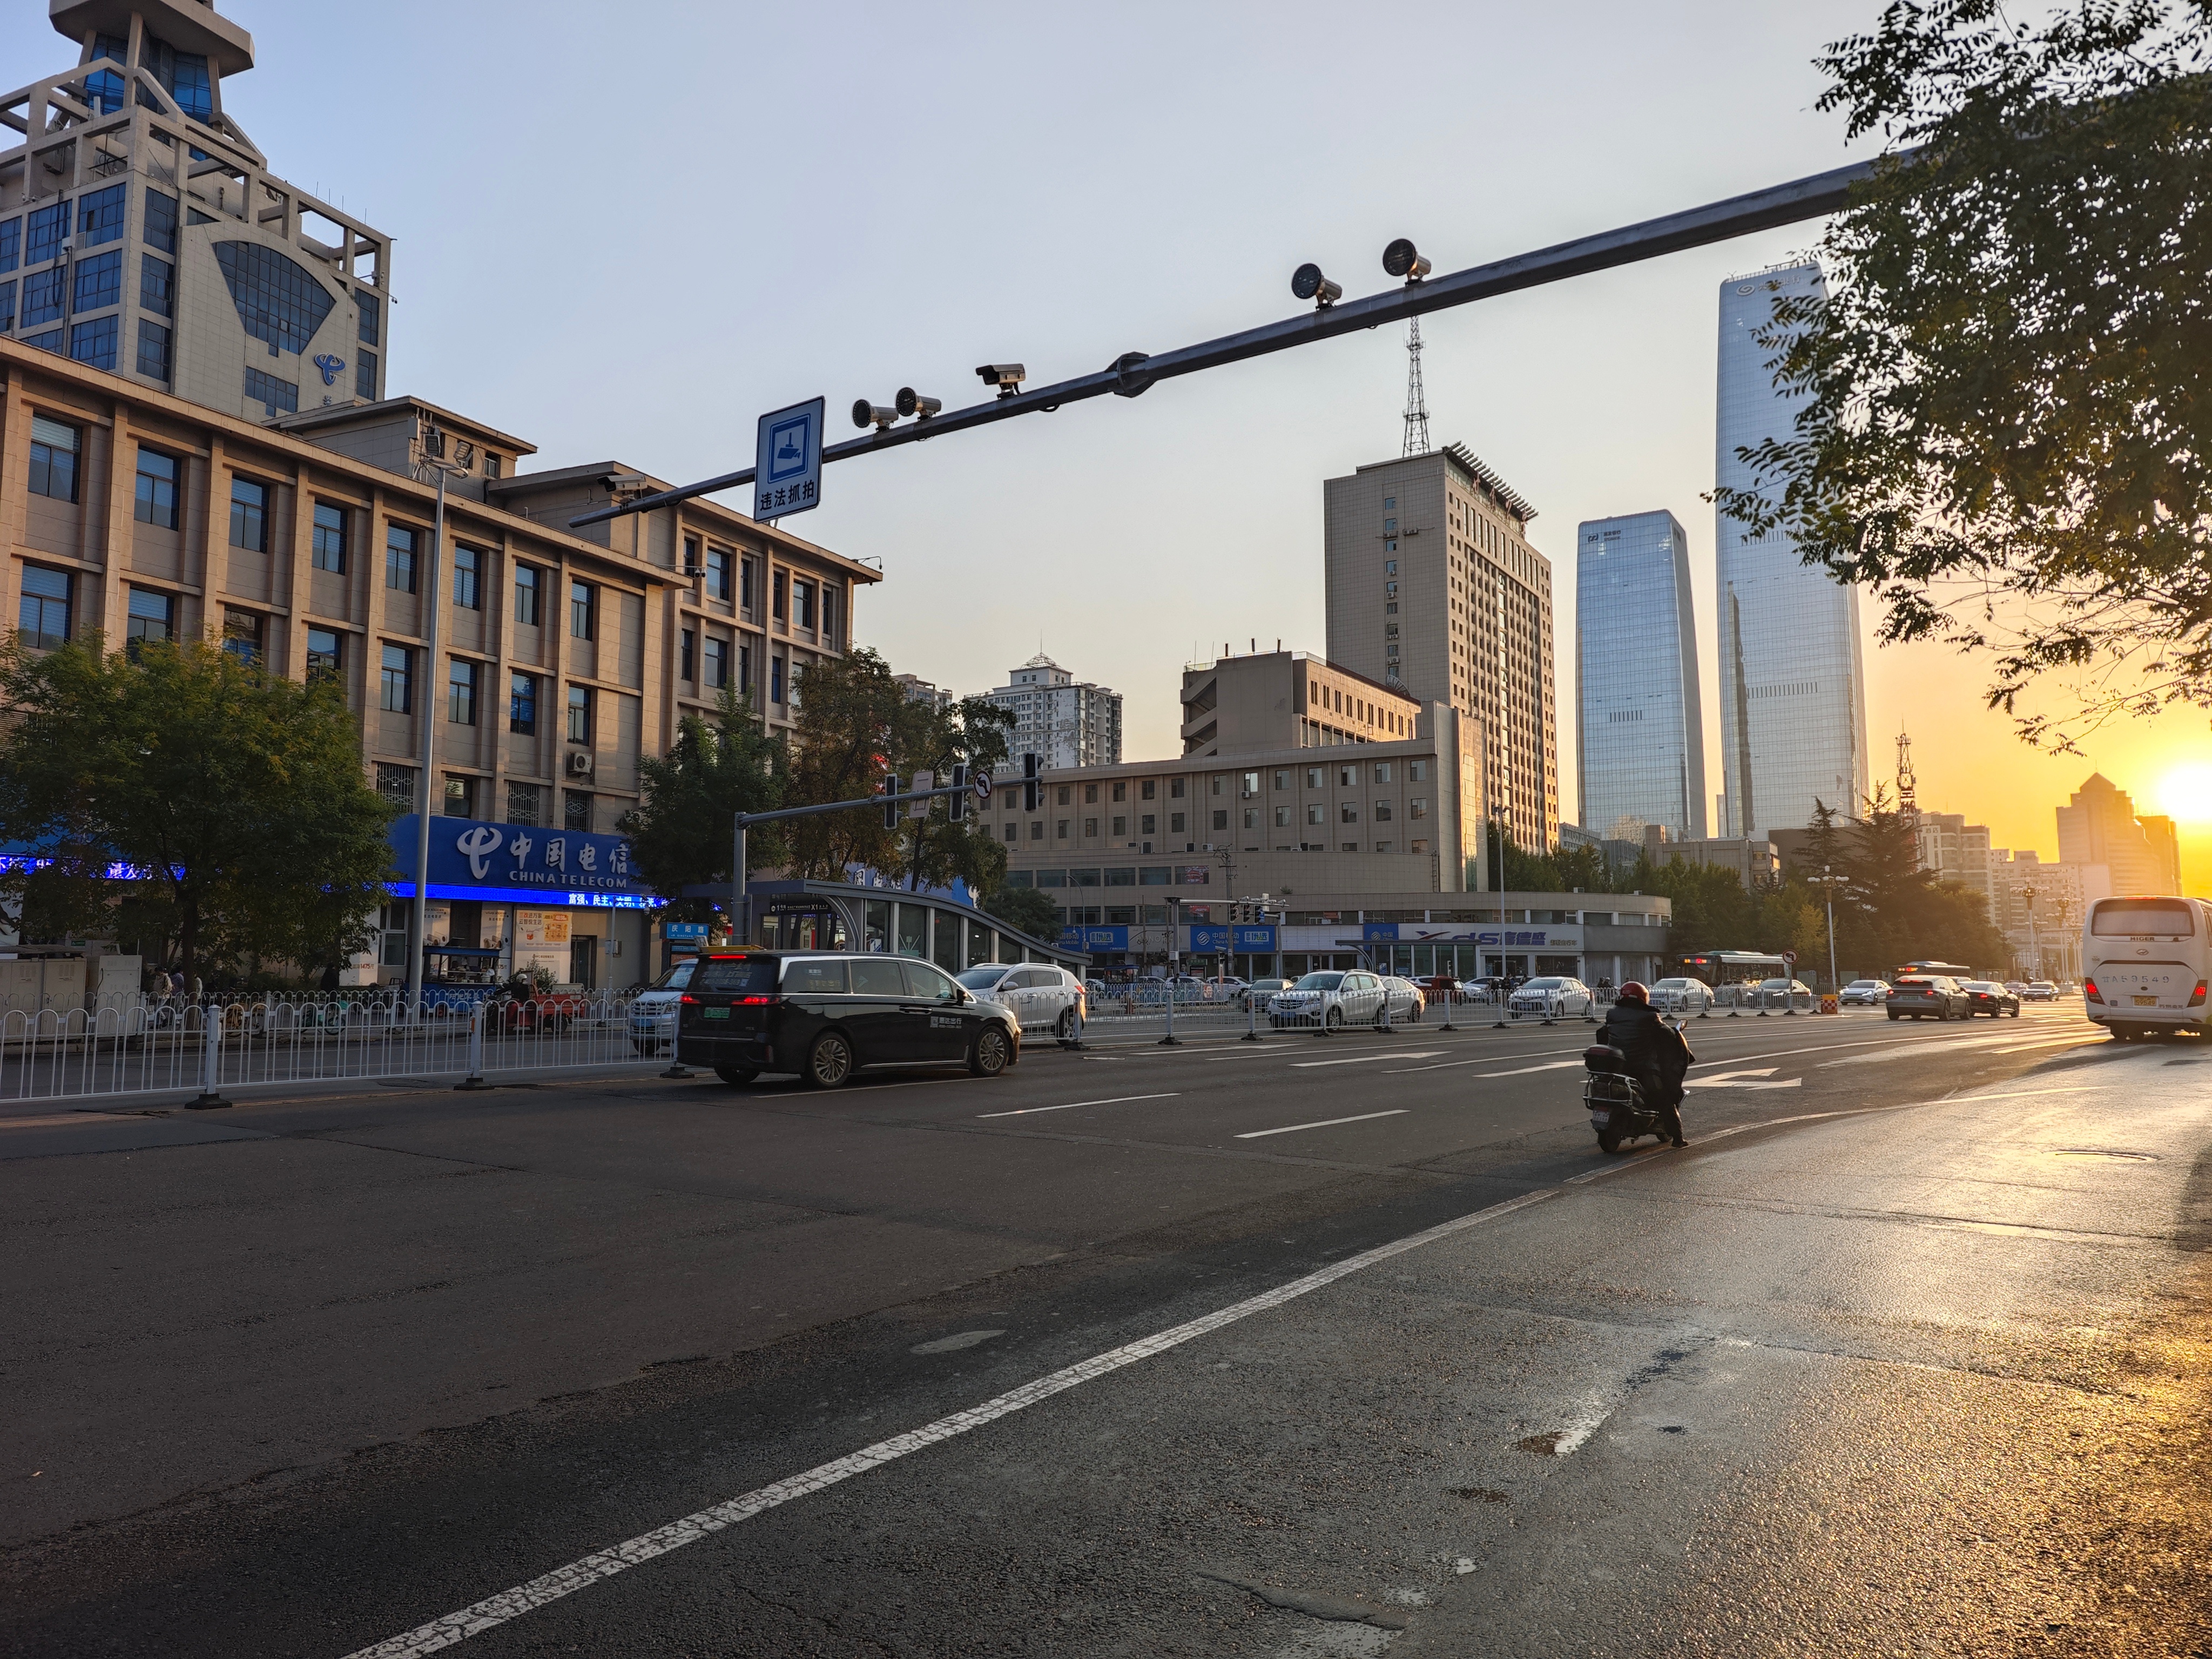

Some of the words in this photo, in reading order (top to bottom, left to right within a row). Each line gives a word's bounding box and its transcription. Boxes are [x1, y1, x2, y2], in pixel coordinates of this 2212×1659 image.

[1758, 274, 1800, 291] 兴银行
[760, 480, 814, 511] 违法抓拍
[509, 832, 628, 874] 中国电信
[509, 871, 555, 884] CHINA
[559, 874, 626, 888] TELECOM
[671, 925, 704, 933] 庆阳路
